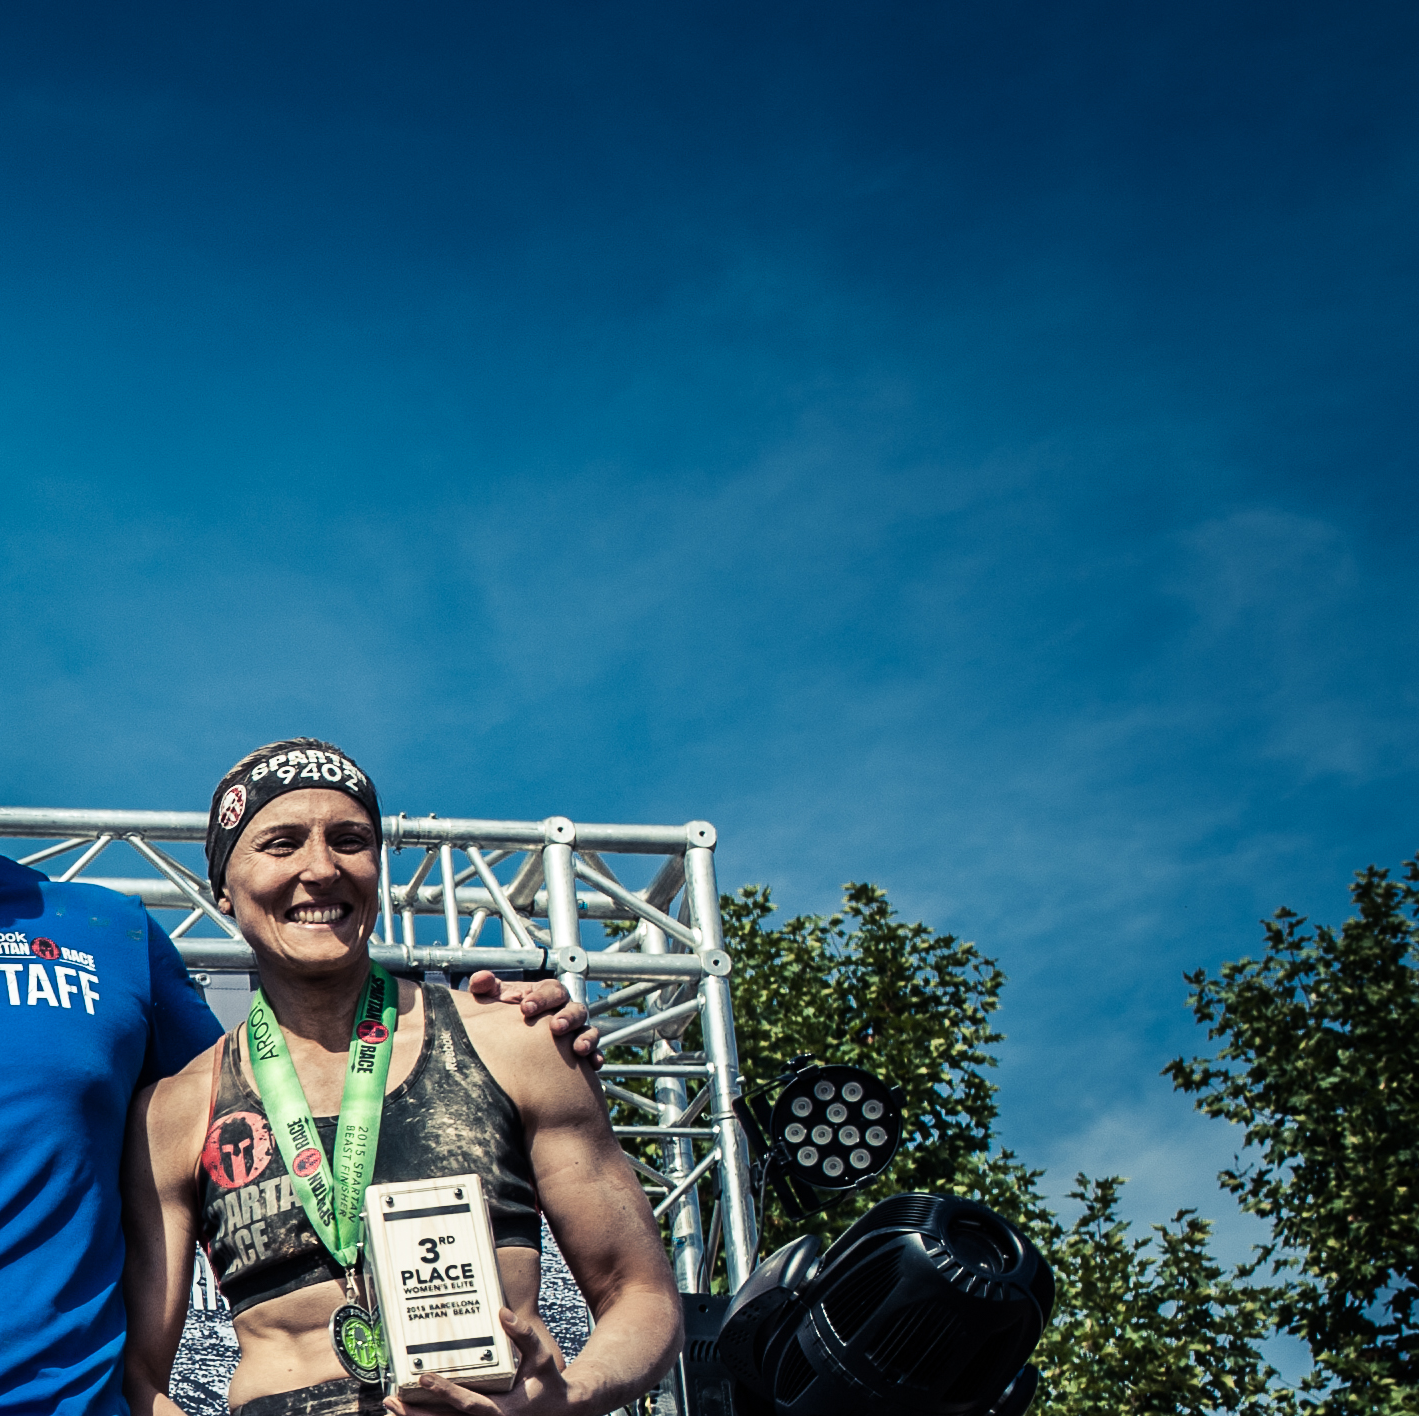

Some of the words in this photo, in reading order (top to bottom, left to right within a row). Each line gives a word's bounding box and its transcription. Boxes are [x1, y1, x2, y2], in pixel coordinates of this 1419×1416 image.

[276, 763, 359, 791] 9402
[61, 947, 95, 968] RACE
[357, 1045, 376, 1073] RACE
[342, 1125, 351, 1161] BEAST
[357, 1126, 368, 1156] 2015
[287, 1117, 310, 1150] RACE
[308, 1171, 336, 1227] SPARTAN
[338, 1165, 350, 1218] FINISHER
[349, 1163, 363, 1223] SPARTAN
[401, 1263, 474, 1286] PLACE
[403, 1283, 448, 1294] WOMEN'S
[451, 1280, 474, 1289] ELITE
[408, 1310, 447, 1321] SPARTAN
[453, 1306, 480, 1316] BEAST
[429, 1300, 480, 1311] BARCELONA
